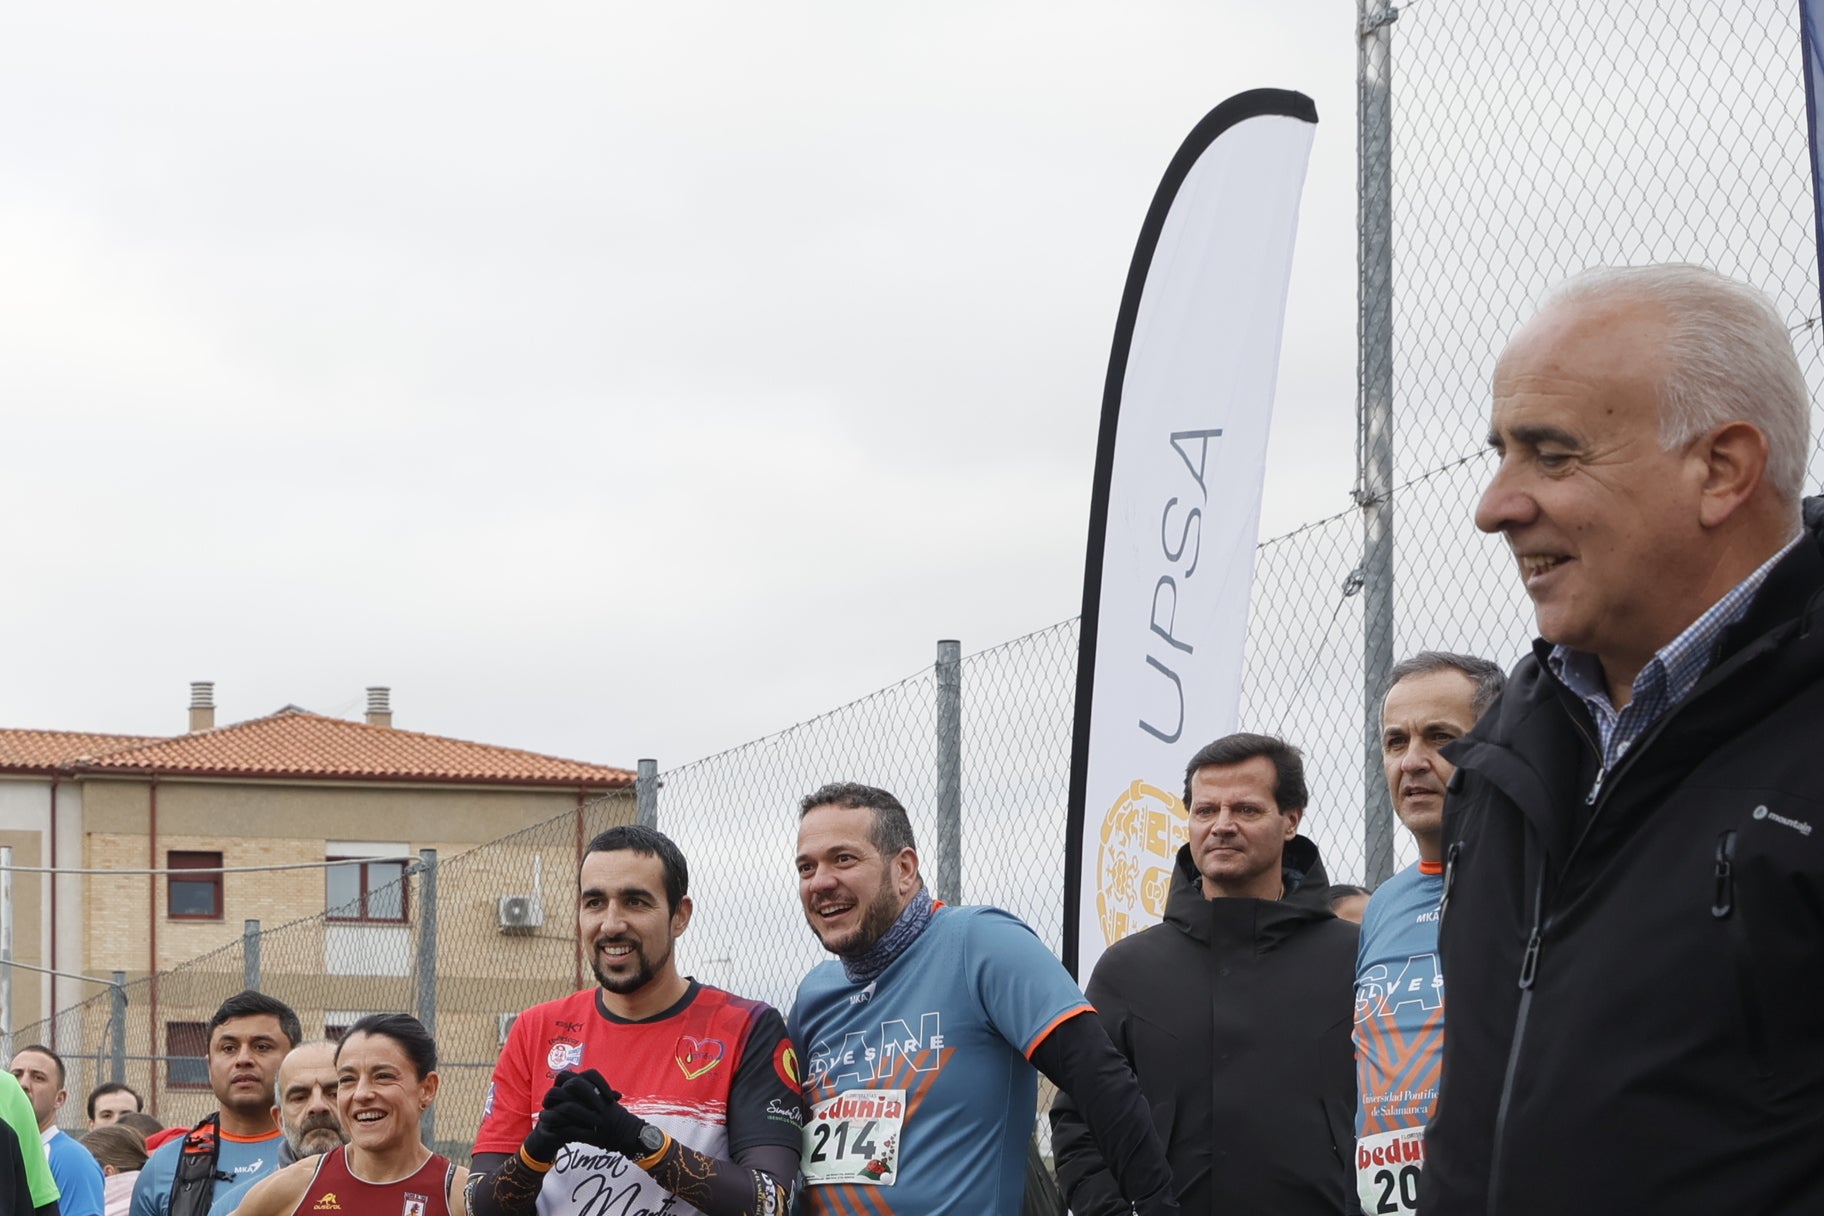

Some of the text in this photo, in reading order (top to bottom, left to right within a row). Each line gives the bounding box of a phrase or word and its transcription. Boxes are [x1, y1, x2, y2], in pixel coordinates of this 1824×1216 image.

[1139, 428, 1223, 744] UPSA
[1380, 1105, 1428, 1117] Salamanca
[810, 1121, 878, 1164] 214
[1358, 1138, 1428, 1170] bedu
